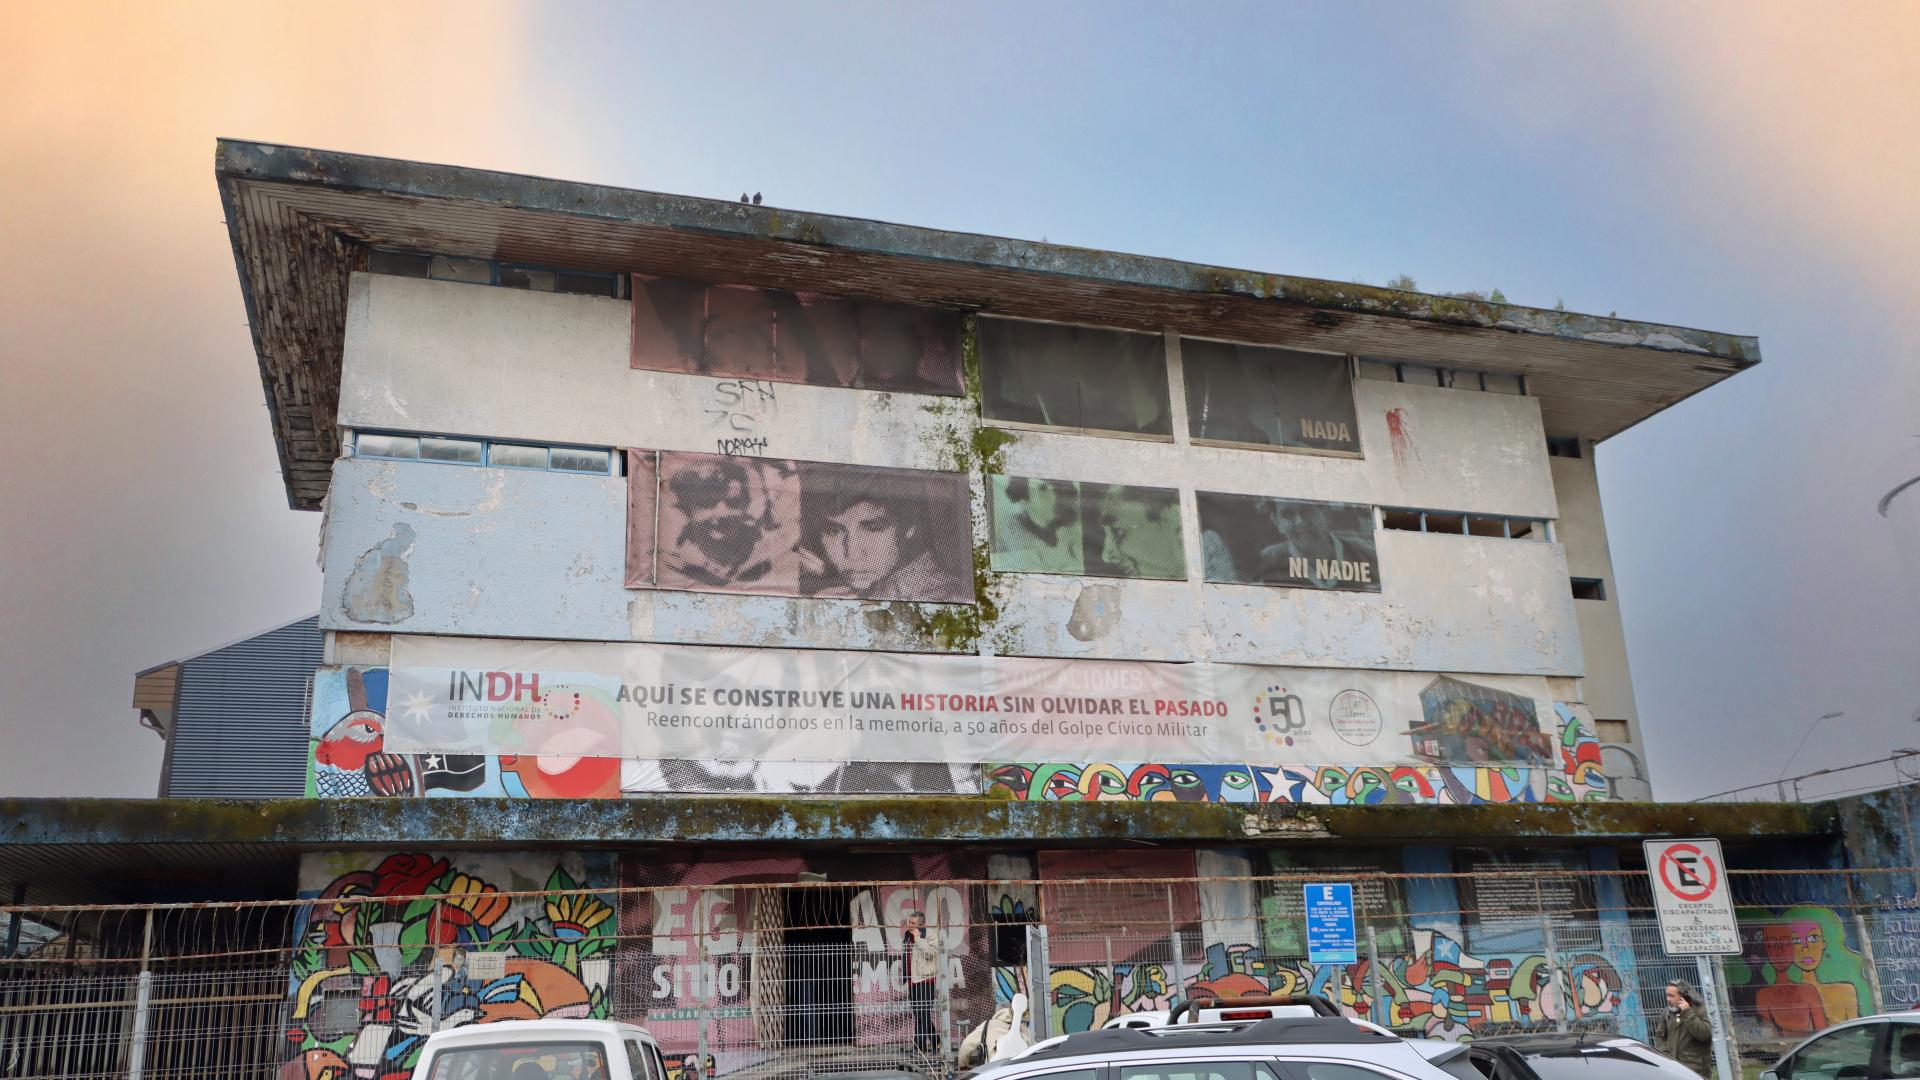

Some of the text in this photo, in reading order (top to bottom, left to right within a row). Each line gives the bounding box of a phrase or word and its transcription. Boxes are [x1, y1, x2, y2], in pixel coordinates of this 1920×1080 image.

[1300, 418, 1351, 442] NADA
[1288, 557, 1372, 583] NI NADIE
[449, 671, 542, 702] INDH
[616, 683, 1228, 717] AQUÍ SE CONSTRUYE UNA HISTORIA SIN OLVIDAR EL PASADO
[647, 711, 1208, 738] Reencontrándonos en la memoria, a 50 años del Golpe Cívico Militar
[1268, 694, 1306, 734] 50
[1676, 857, 1702, 886] E
[1323, 886, 1334, 900] E
